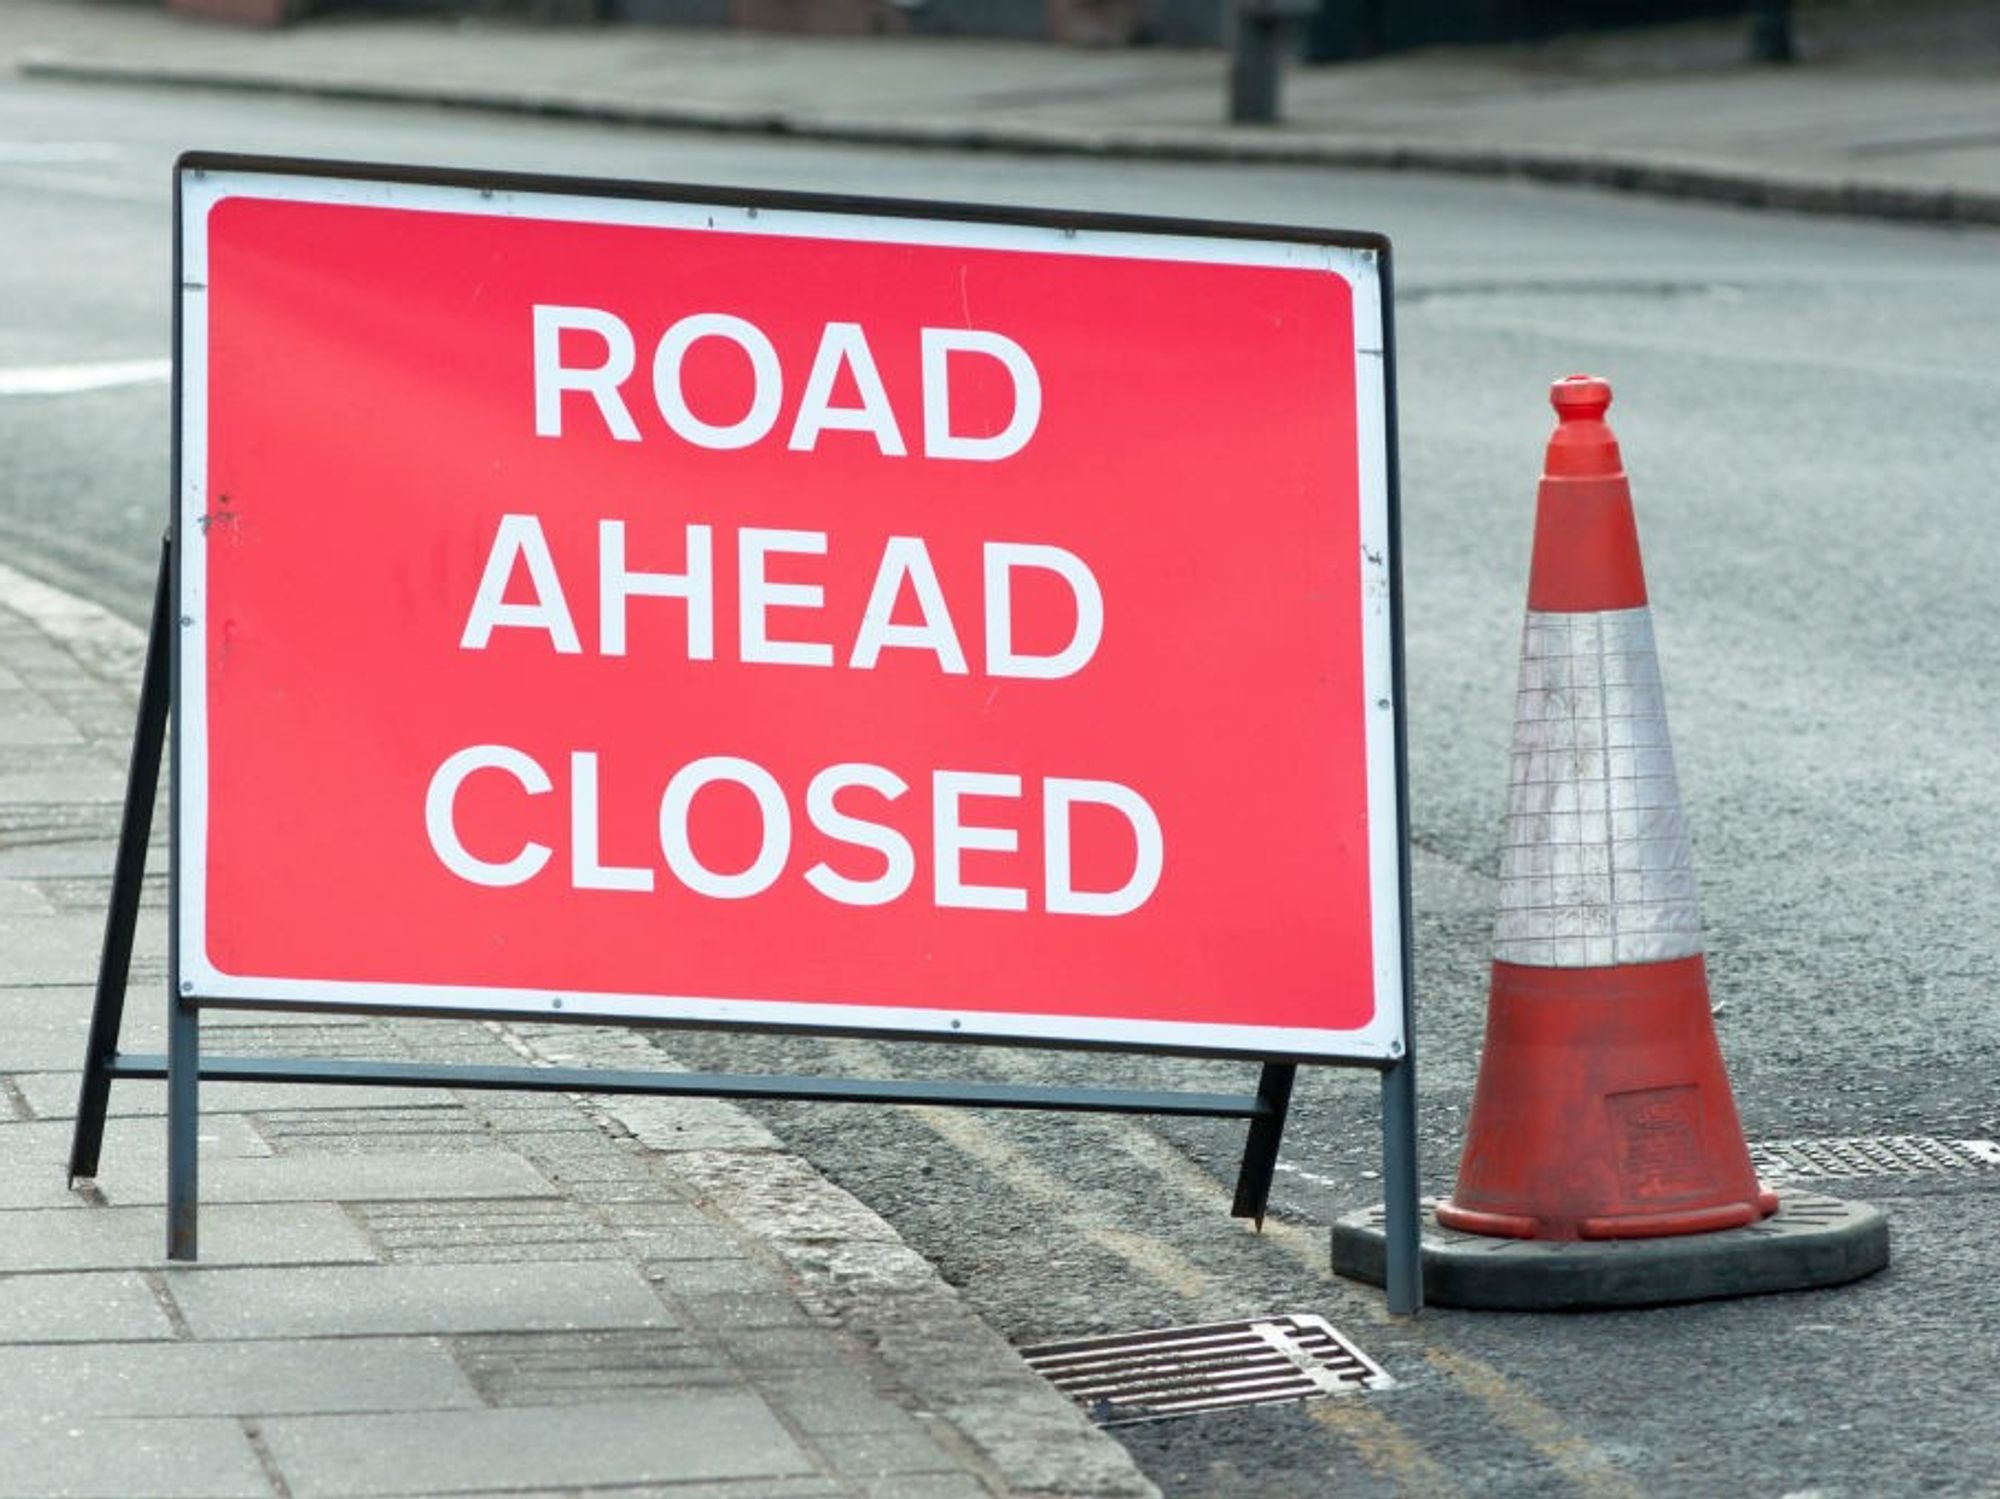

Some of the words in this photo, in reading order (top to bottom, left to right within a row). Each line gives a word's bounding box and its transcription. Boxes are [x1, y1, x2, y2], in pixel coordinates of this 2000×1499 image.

[531, 303, 1043, 463] ROAD
[458, 512, 1105, 681] AHEAD
[423, 743, 1165, 918] CLOSED
